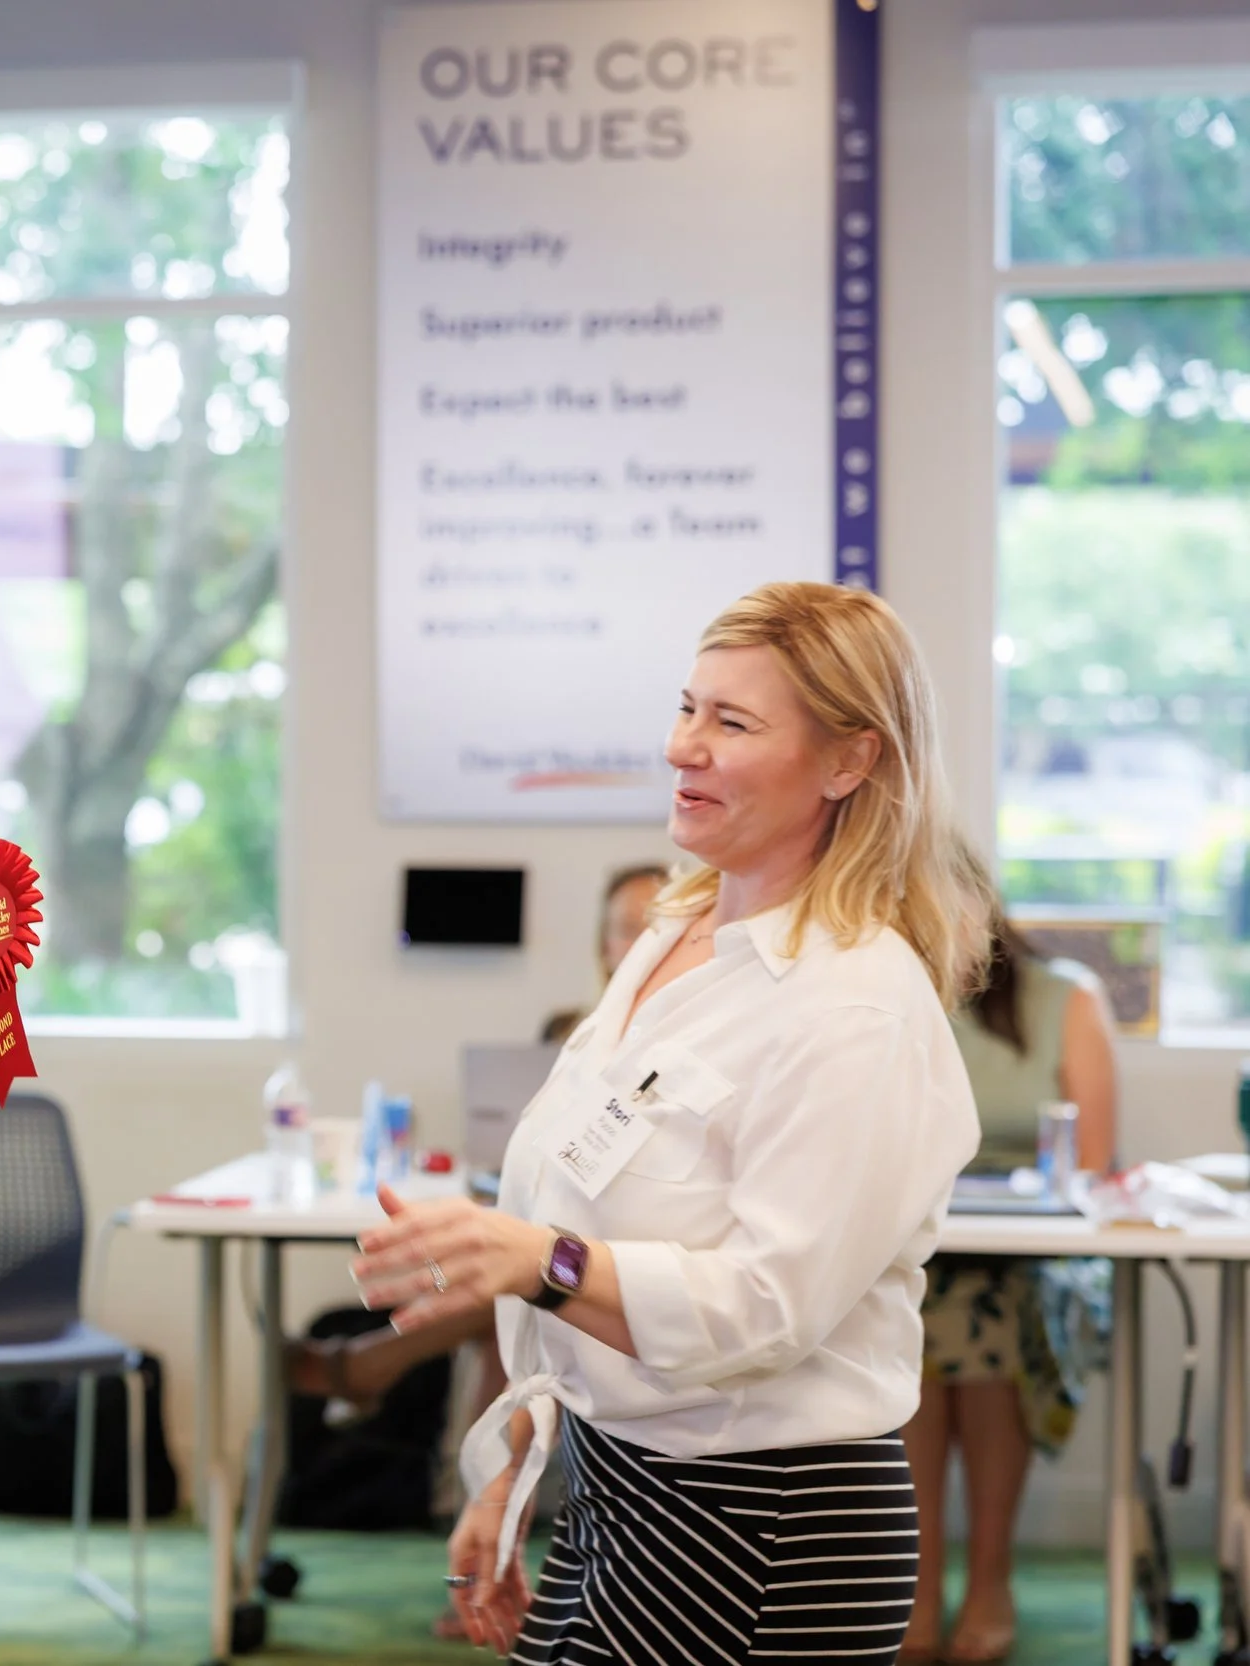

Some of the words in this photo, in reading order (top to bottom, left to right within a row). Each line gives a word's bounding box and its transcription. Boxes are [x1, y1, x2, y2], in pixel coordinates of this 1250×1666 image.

[419, 43, 572, 101] OUR
[594, 35, 796, 93] CORE
[416, 106, 691, 165] VALUES
[418, 227, 570, 269] Integrity
[419, 303, 572, 347] Superior
[581, 300, 723, 347] product
[418, 383, 536, 424] Expect
[546, 381, 603, 415] the
[610, 375, 687, 415] best
